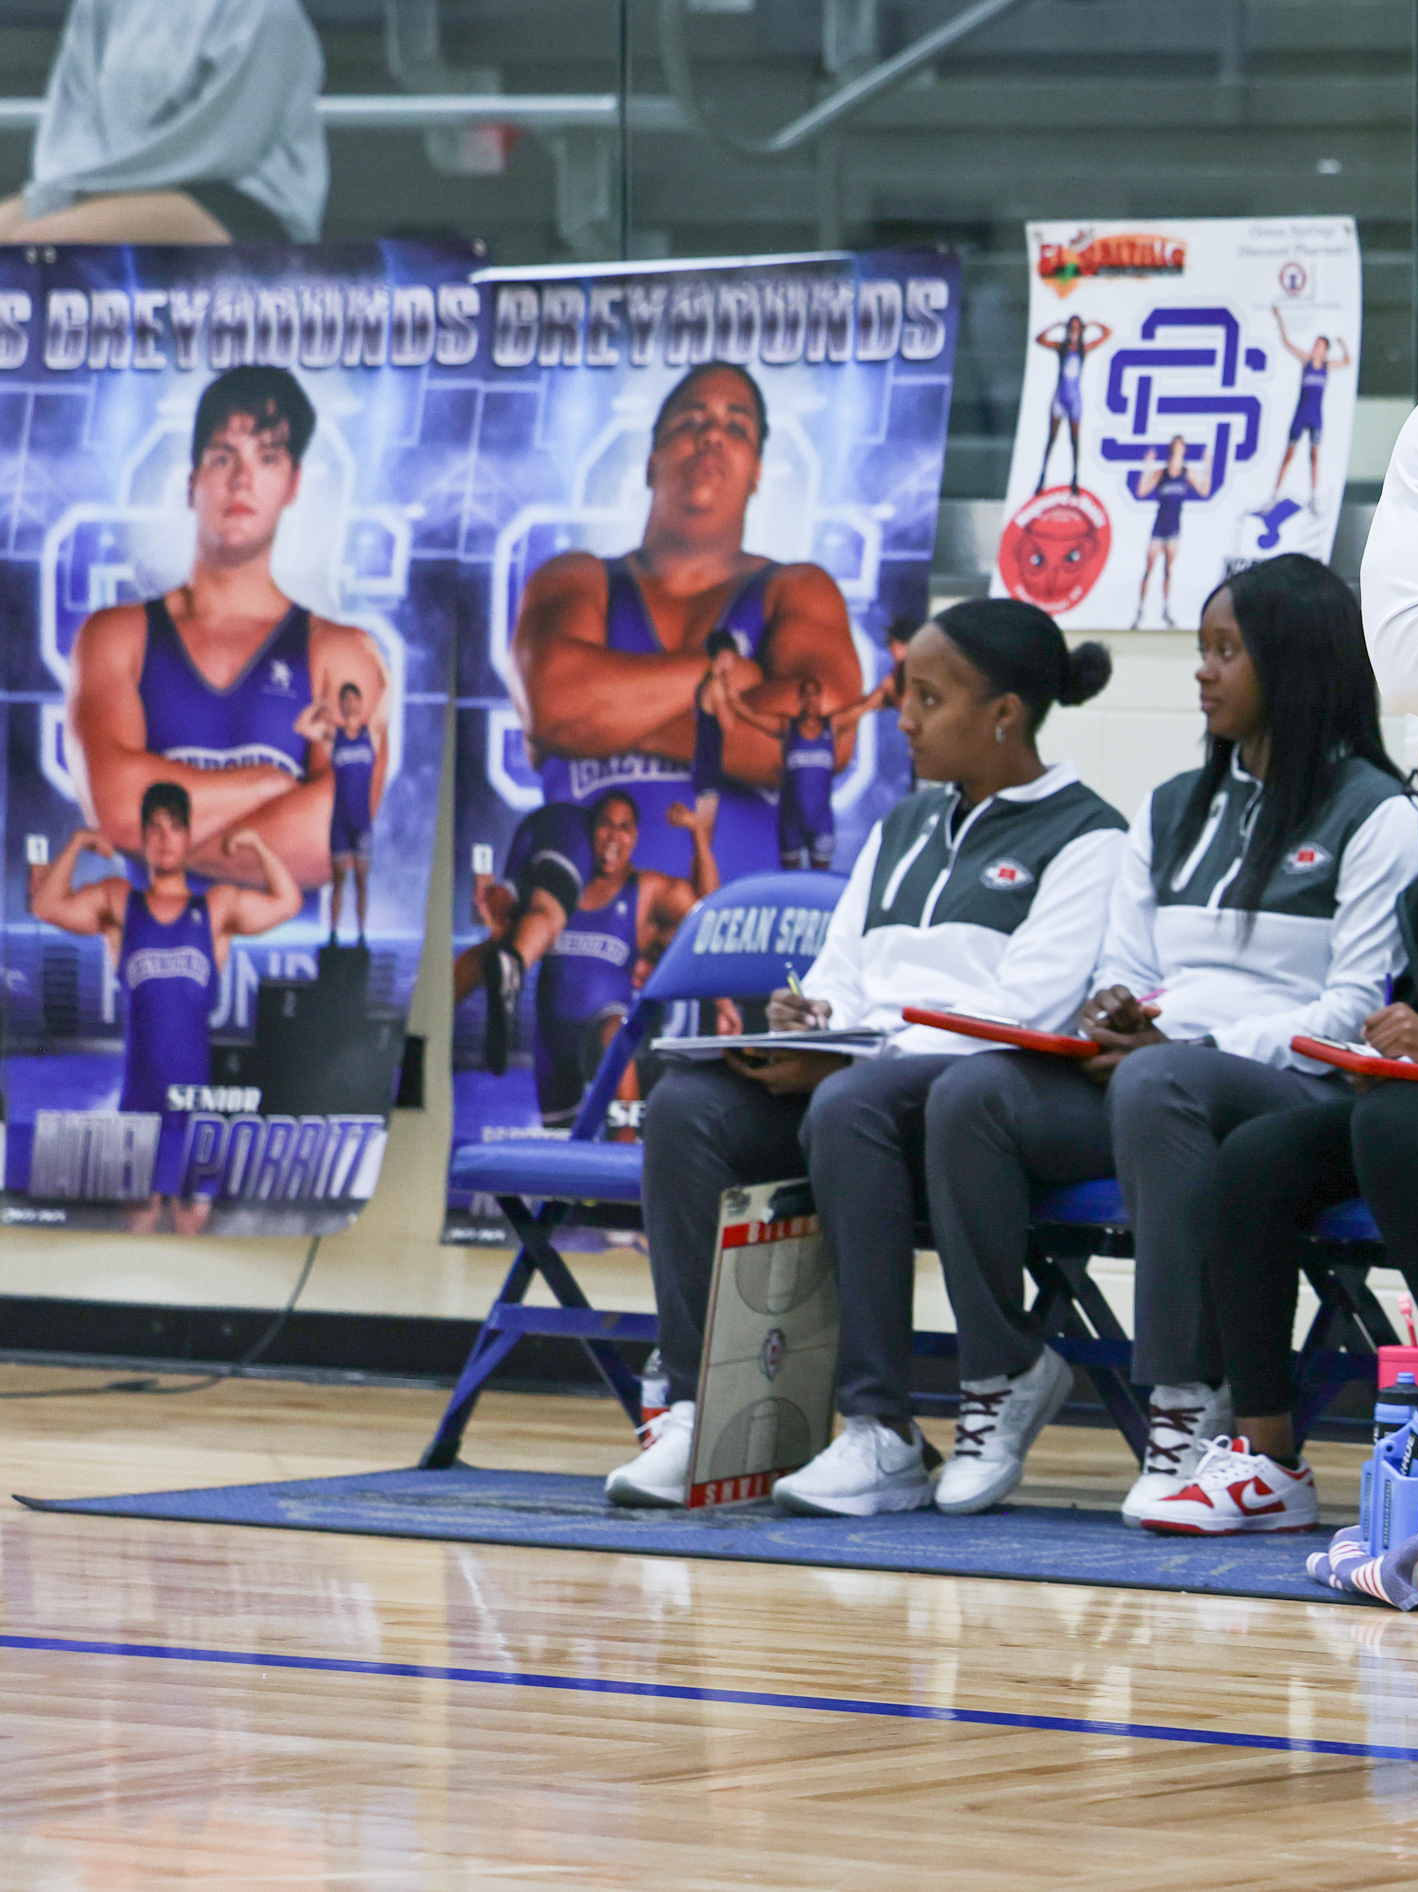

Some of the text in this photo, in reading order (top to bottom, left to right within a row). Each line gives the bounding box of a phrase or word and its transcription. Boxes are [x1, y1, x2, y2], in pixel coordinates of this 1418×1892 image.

[44, 284, 481, 370] GREYHOUNDS
[493, 279, 948, 367] GREYHOUNDS
[692, 906, 778, 955] OCEAN
[166, 1084, 262, 1113] SENIOR
